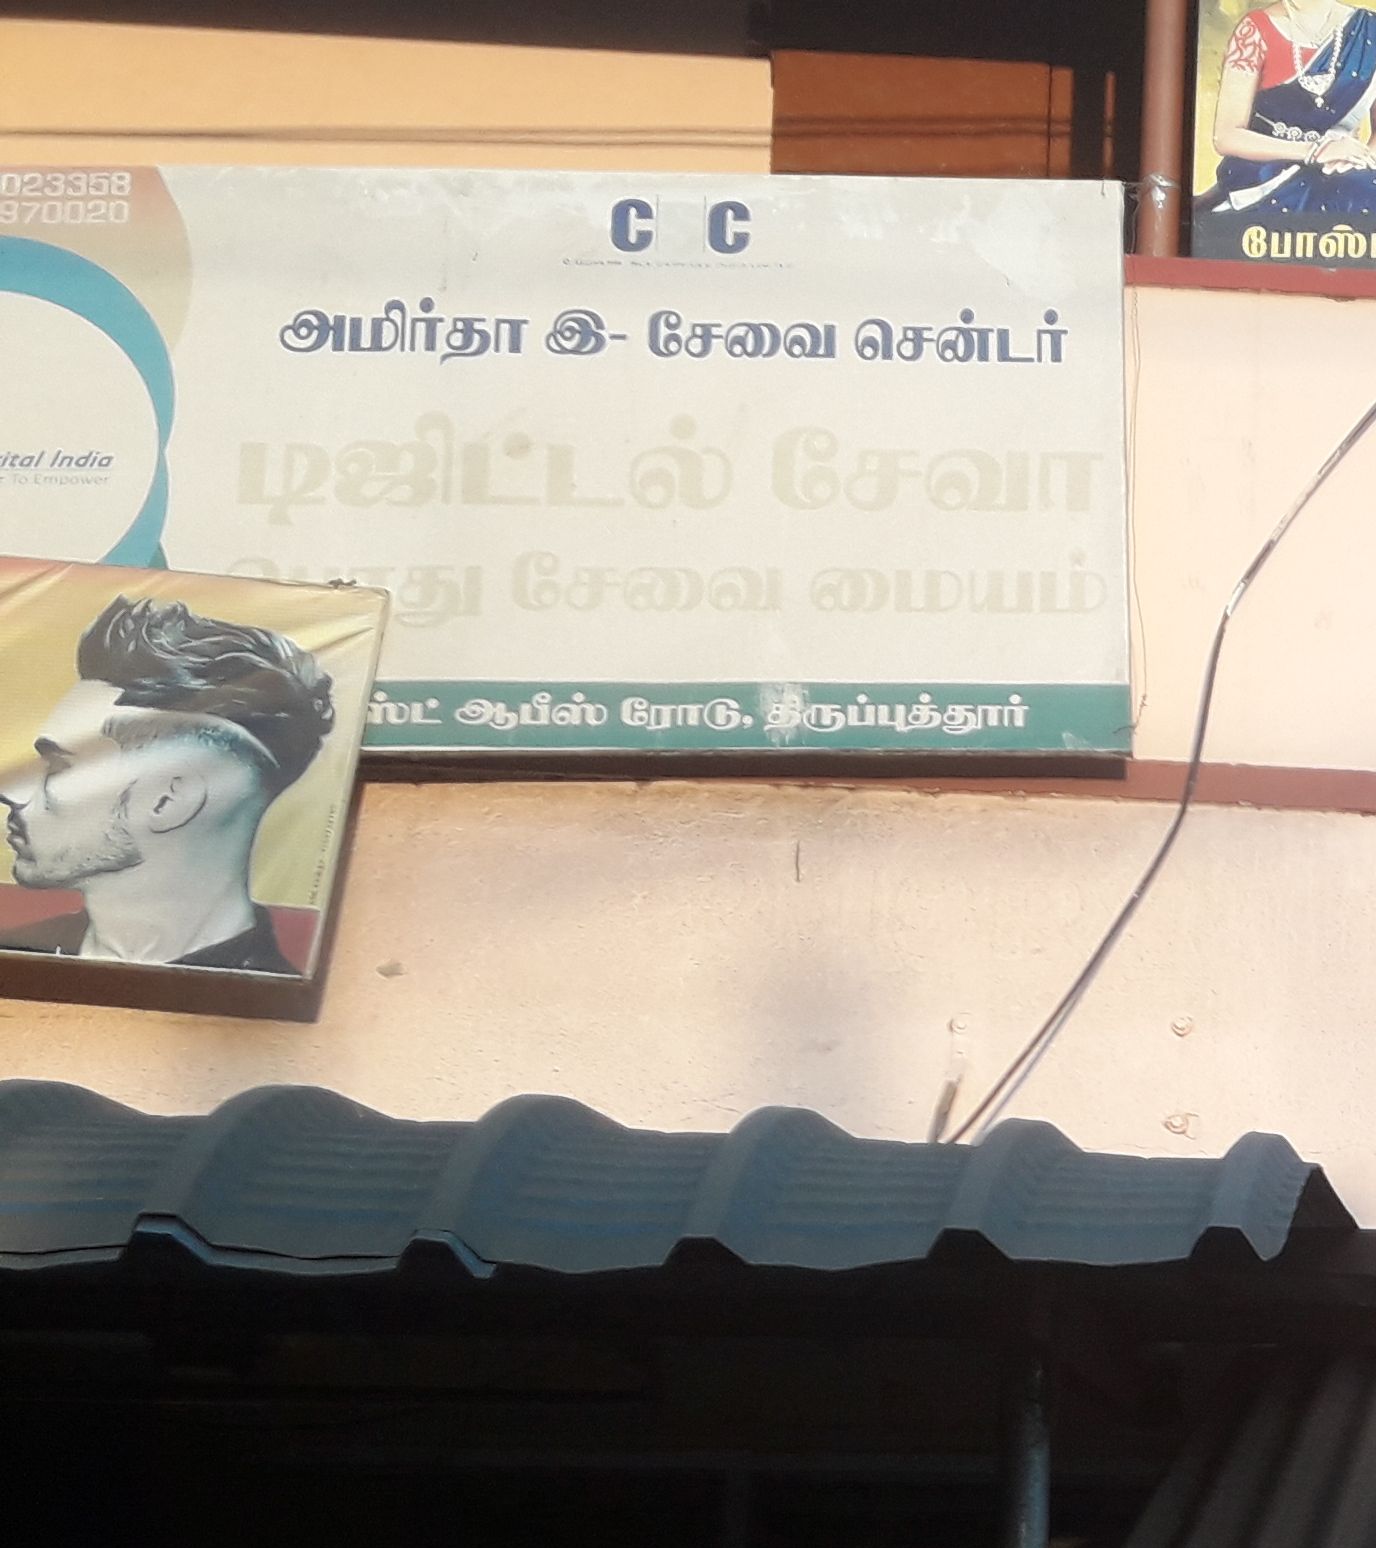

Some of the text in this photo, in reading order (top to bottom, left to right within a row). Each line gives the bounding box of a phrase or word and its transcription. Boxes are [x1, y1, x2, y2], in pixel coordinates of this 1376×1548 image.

[0, 172, 131, 196] 023358
[0, 200, 129, 224] 970020
[280, 296, 530, 366] அமிர்தா
[648, 309, 837, 360] சேவை
[855, 307, 1068, 364] சென்டர்
[0, 449, 114, 469] ital India
[238, 410, 1104, 526] டிஜிட்டல் சேவா
[510, 549, 784, 614] சேவை
[810, 547, 1108, 615] மையம்
[367, 690, 441, 727] ஸ்ட்
[454, 690, 608, 731] ஆபீஸ்
